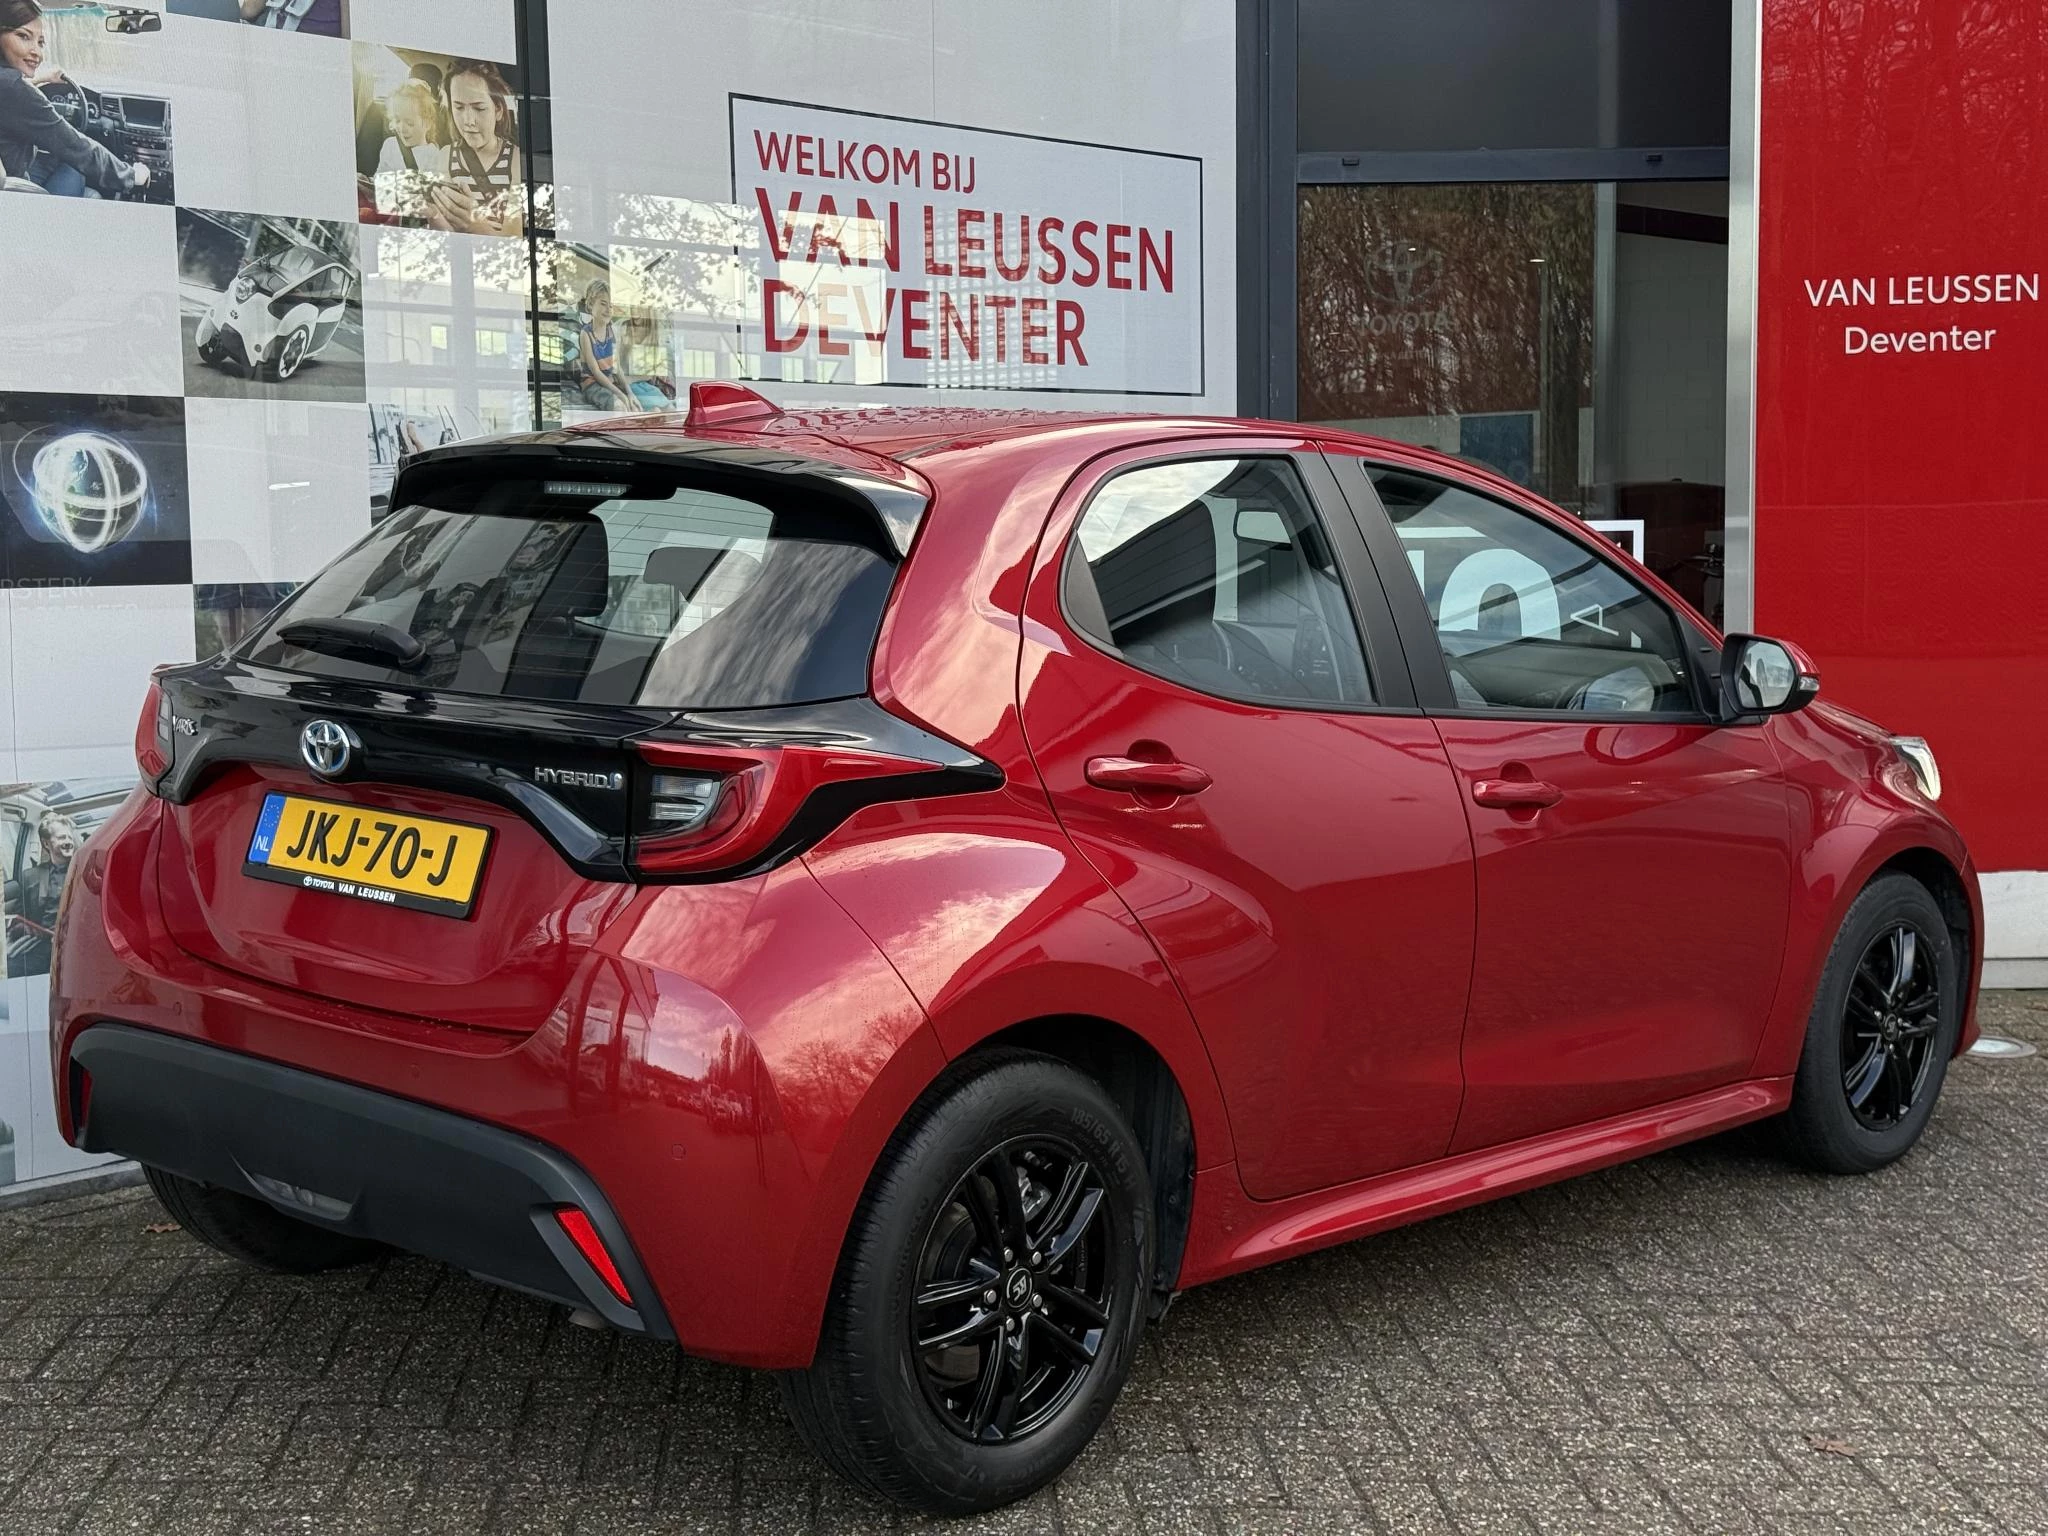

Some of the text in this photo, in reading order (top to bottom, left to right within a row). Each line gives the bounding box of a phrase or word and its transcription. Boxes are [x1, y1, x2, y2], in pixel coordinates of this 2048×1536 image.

[753, 129, 976, 194] WELKOM BIJ
[754, 187, 1174, 293] VAN LEUSSEN
[1803, 273, 2039, 307] VAN LEUSSEN
[763, 278, 1089, 367] DEVENTER
[1844, 325, 1997, 355] Deventer
[534, 766, 608, 789] HYBRID
[255, 834, 270, 852] NL
[286, 809, 458, 887] JKJ-70-J
[313, 878, 396, 902] TOYOTA VAN LEUSSEN
